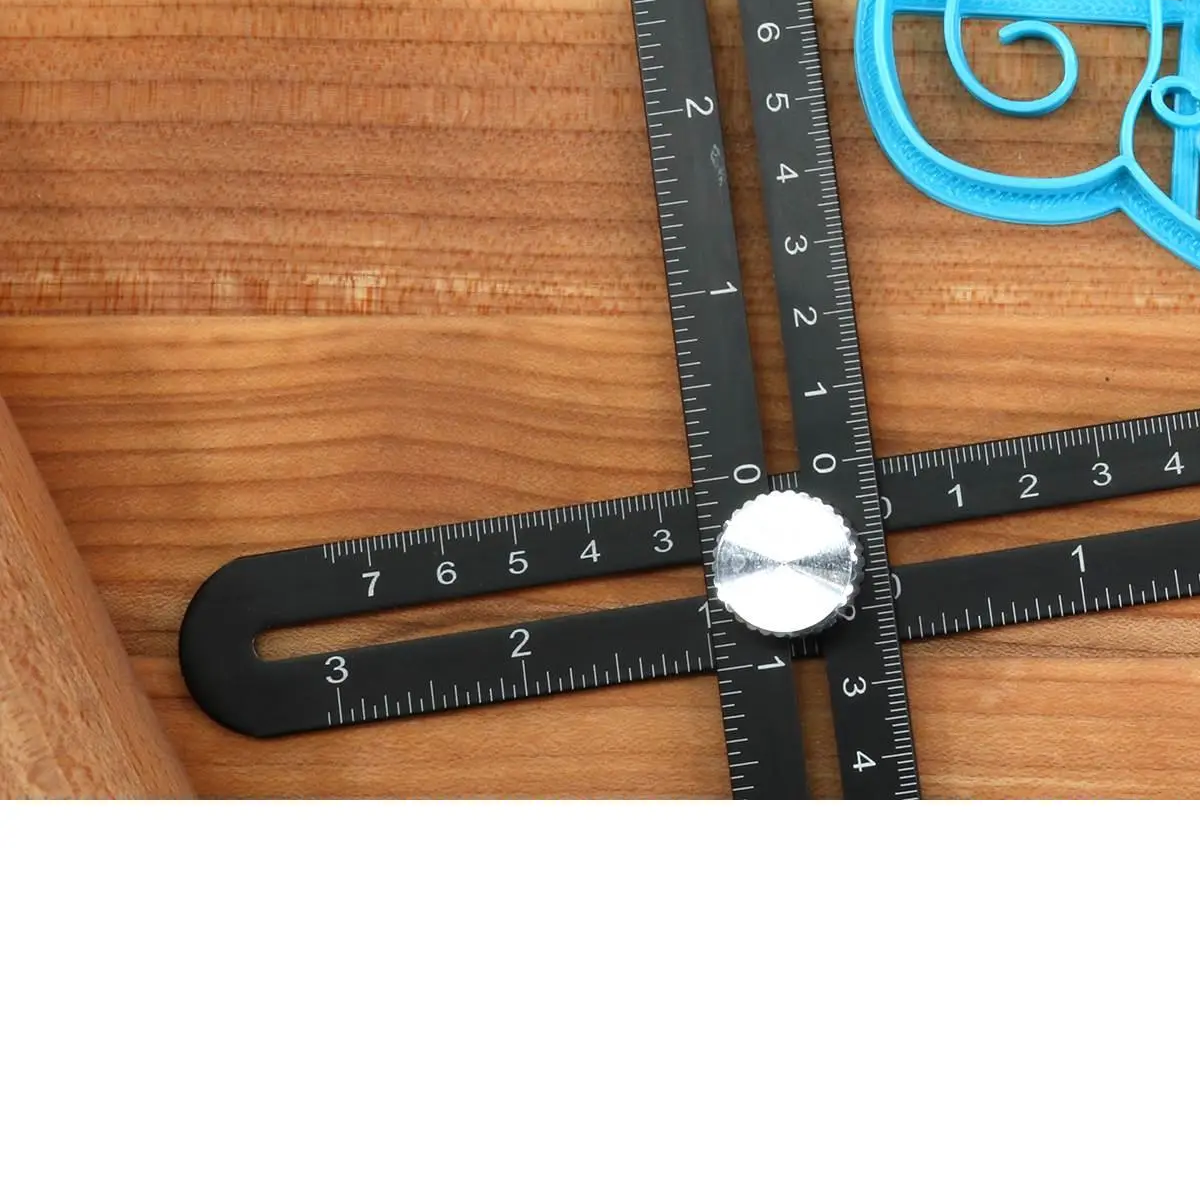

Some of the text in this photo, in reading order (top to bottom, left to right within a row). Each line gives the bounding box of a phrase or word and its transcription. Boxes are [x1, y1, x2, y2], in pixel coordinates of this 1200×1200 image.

[757, 22, 780, 43] 6
[766, 93, 789, 112] 5
[776, 163, 799, 183] 4
[785, 235, 808, 255] 3
[793, 307, 817, 327] 2
[685, 96, 714, 118] 2
[710, 281, 738, 295] 1
[734, 464, 761, 484] 0
[758, 656, 785, 669] 1
[804, 382, 827, 397] 1
[813, 453, 836, 473] 0
[948, 484, 963, 507] 1
[1019, 474, 1039, 498] 2
[1092, 463, 1112, 486] 3
[1164, 452, 1184, 474] 4
[362, 529, 673, 597] 7 6 5 4 3
[1072, 545, 1085, 572] 1
[325, 601, 711, 683] 3 2 1
[843, 677, 866, 697] 3
[853, 751, 876, 772] 4
